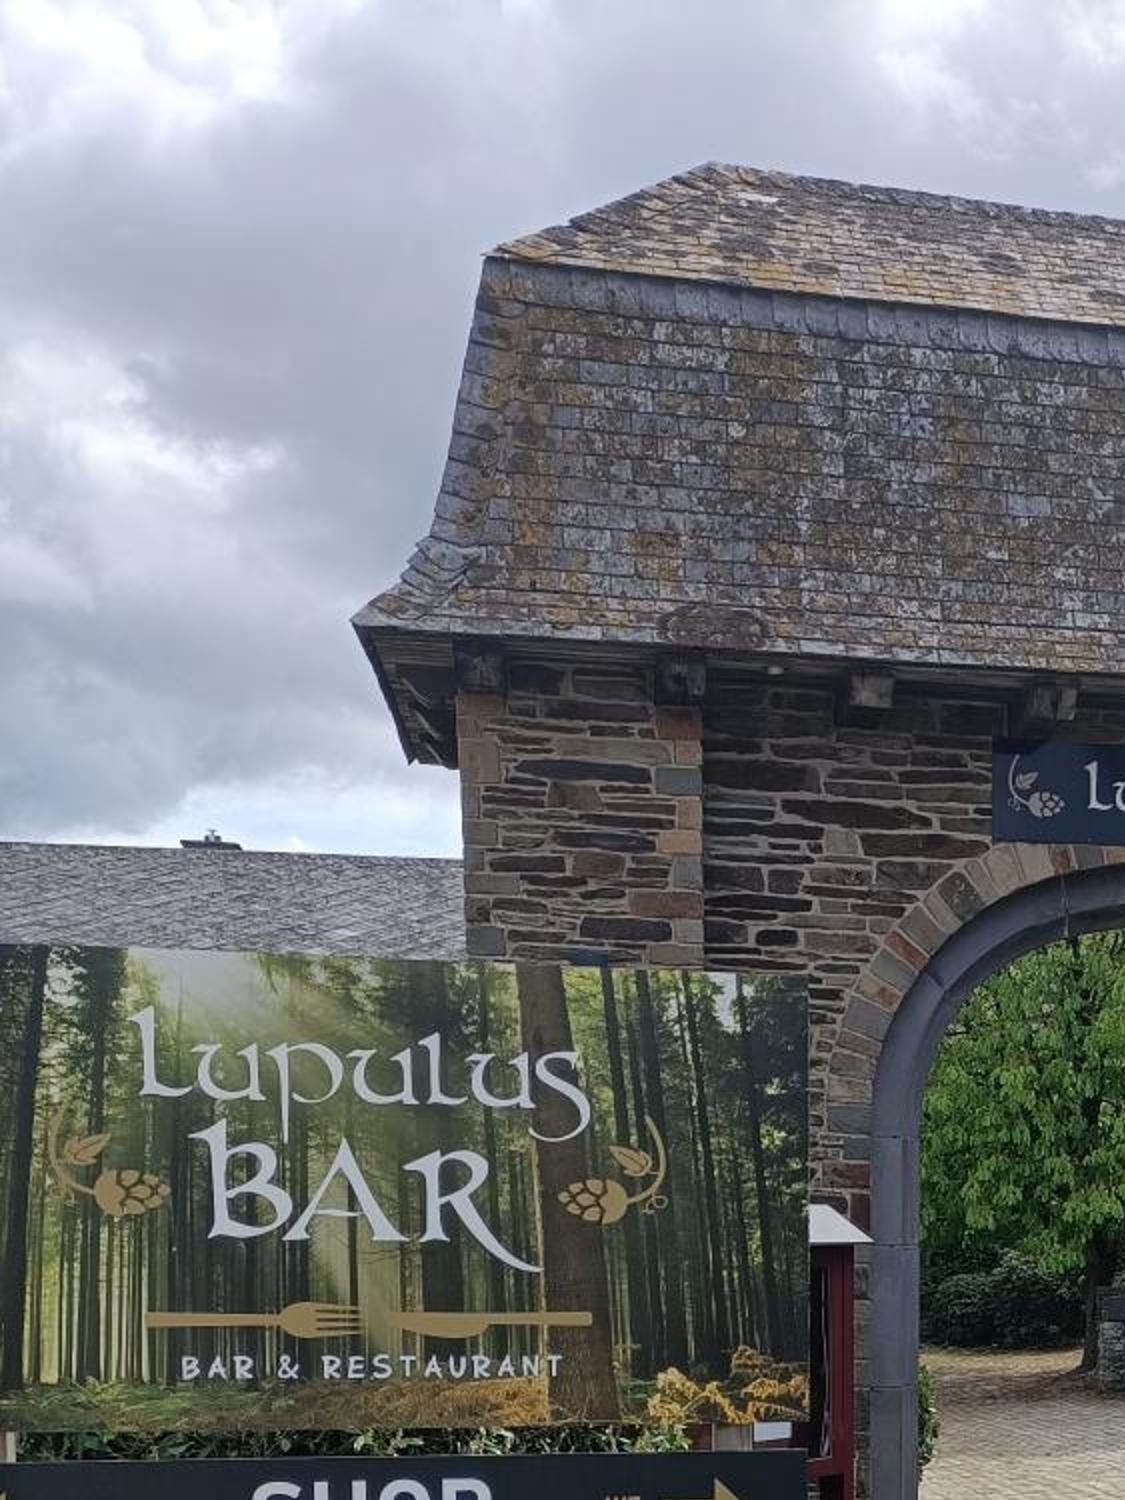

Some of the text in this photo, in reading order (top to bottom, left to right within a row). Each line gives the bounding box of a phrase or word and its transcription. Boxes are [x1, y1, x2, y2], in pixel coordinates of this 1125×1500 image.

[127, 1003, 592, 1144] Lupulus
[189, 1117, 545, 1273] BAR
[180, 1352, 564, 1381] BAR & RESTAURANT
